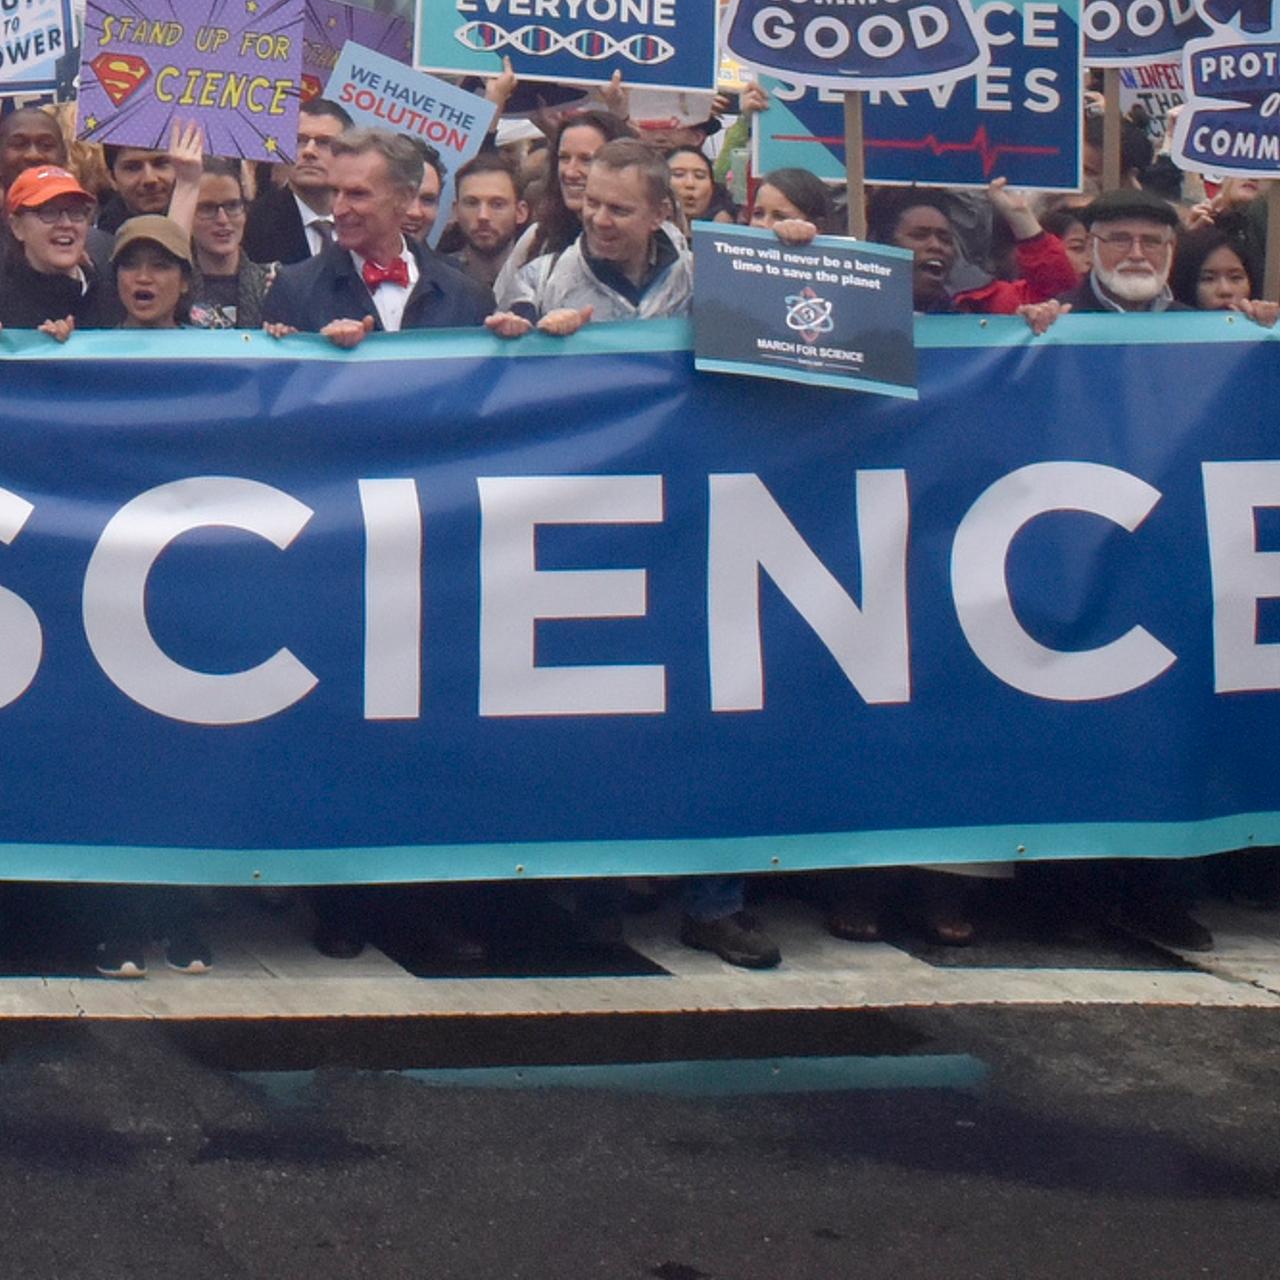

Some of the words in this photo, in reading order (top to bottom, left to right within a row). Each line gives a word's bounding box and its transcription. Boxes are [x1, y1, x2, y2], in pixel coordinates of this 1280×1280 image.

[3, 16, 21, 36] TO
[97, 14, 184, 48] STAND
[196, 21, 231, 54] UP
[239, 31, 291, 62] FOR
[751, 5, 950, 59] GOOD
[1200, 51, 1280, 83] PROT
[349, 64, 382, 91] WE
[384, 78, 437, 113] HAVE
[438, 102, 476, 131] THE
[338, 82, 469, 152] SOLUTION
[714, 241, 755, 258] There
[757, 248, 781, 262] will
[783, 253, 820, 267] never
[823, 254, 841, 268] be
[843, 260, 853, 269] a
[855, 260, 893, 278] better
[732, 260, 764, 274] time
[766, 264, 780, 276] to
[782, 269, 813, 281] save
[815, 271, 839, 284] the
[841, 274, 882, 291] planet
[756, 338, 796, 354] MARCH
[796, 344, 818, 357] FOR
[819, 347, 865, 363] SCIENCE
